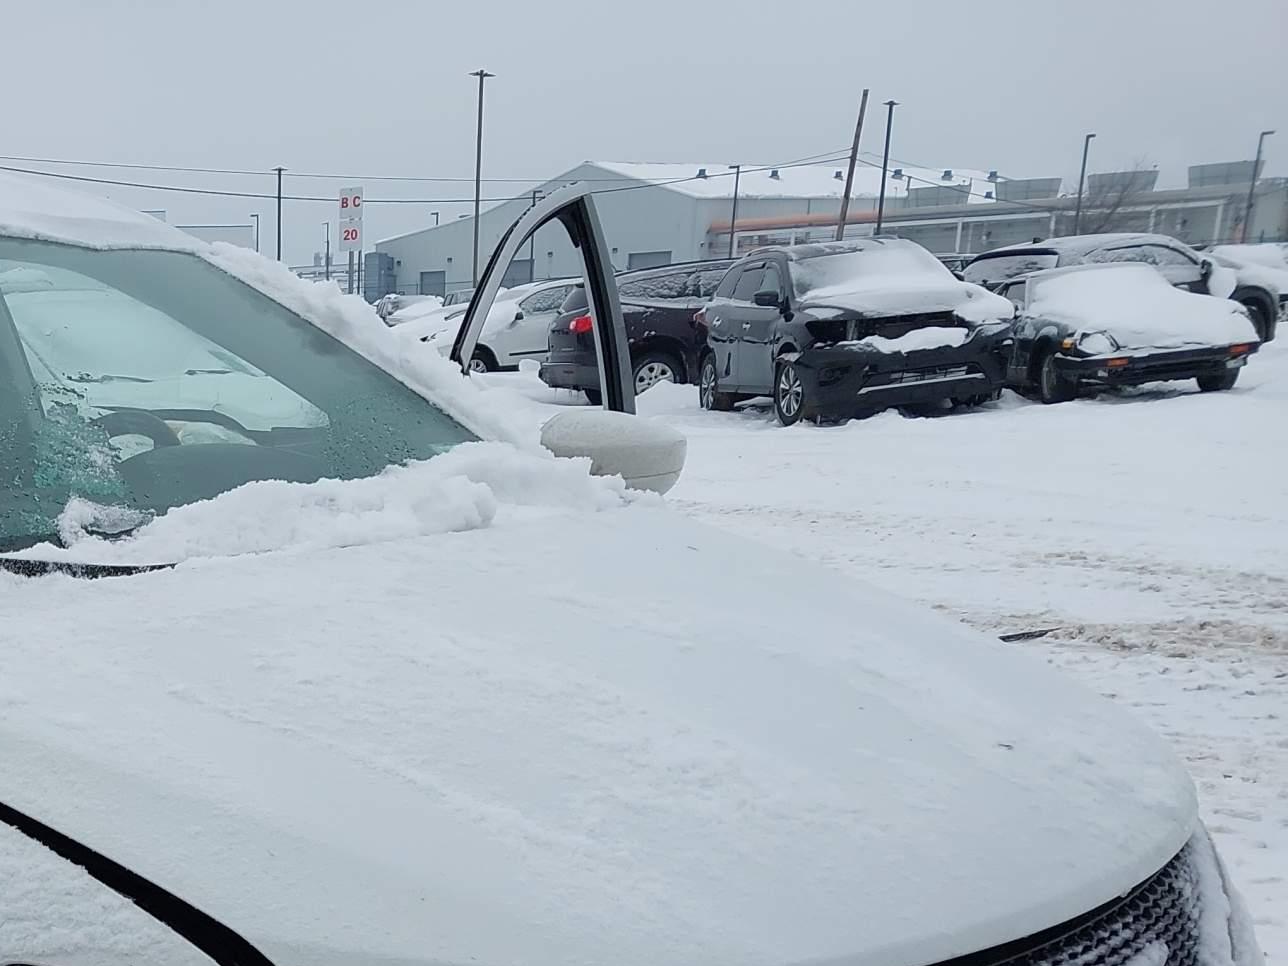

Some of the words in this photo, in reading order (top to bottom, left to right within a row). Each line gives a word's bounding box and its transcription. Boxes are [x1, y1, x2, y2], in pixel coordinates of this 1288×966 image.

[341, 197, 349, 209] B
[353, 196, 361, 208] C
[343, 229, 358, 240] 20
